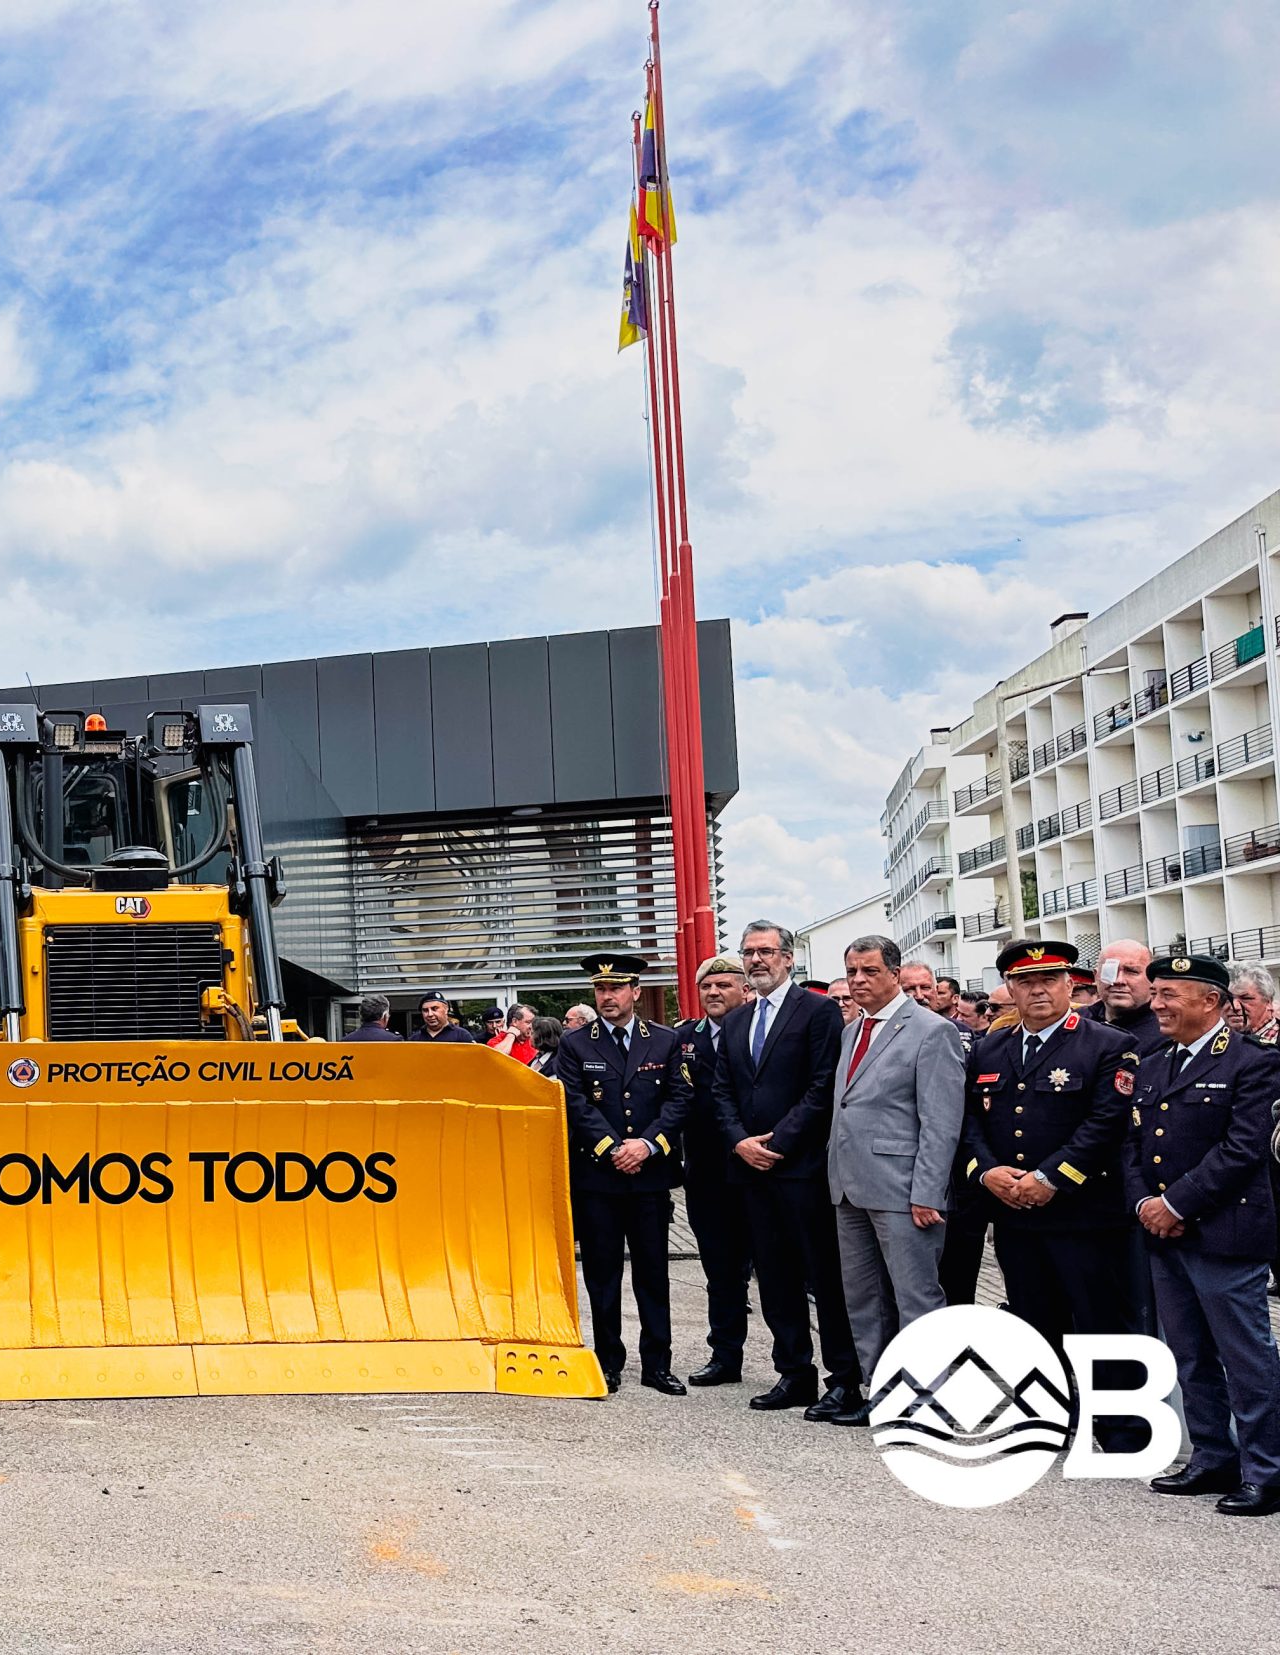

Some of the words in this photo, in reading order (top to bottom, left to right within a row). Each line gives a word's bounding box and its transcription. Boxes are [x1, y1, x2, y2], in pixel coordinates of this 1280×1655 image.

[0, 723, 26, 732] LOUSÃ
[115, 896, 143, 914] CAT
[47, 1055, 191, 1087] PROTEÇÃO
[198, 1061, 262, 1082] CIVIL
[269, 1055, 355, 1081] LOUSÃ
[189, 1150, 398, 1203] TODOS
